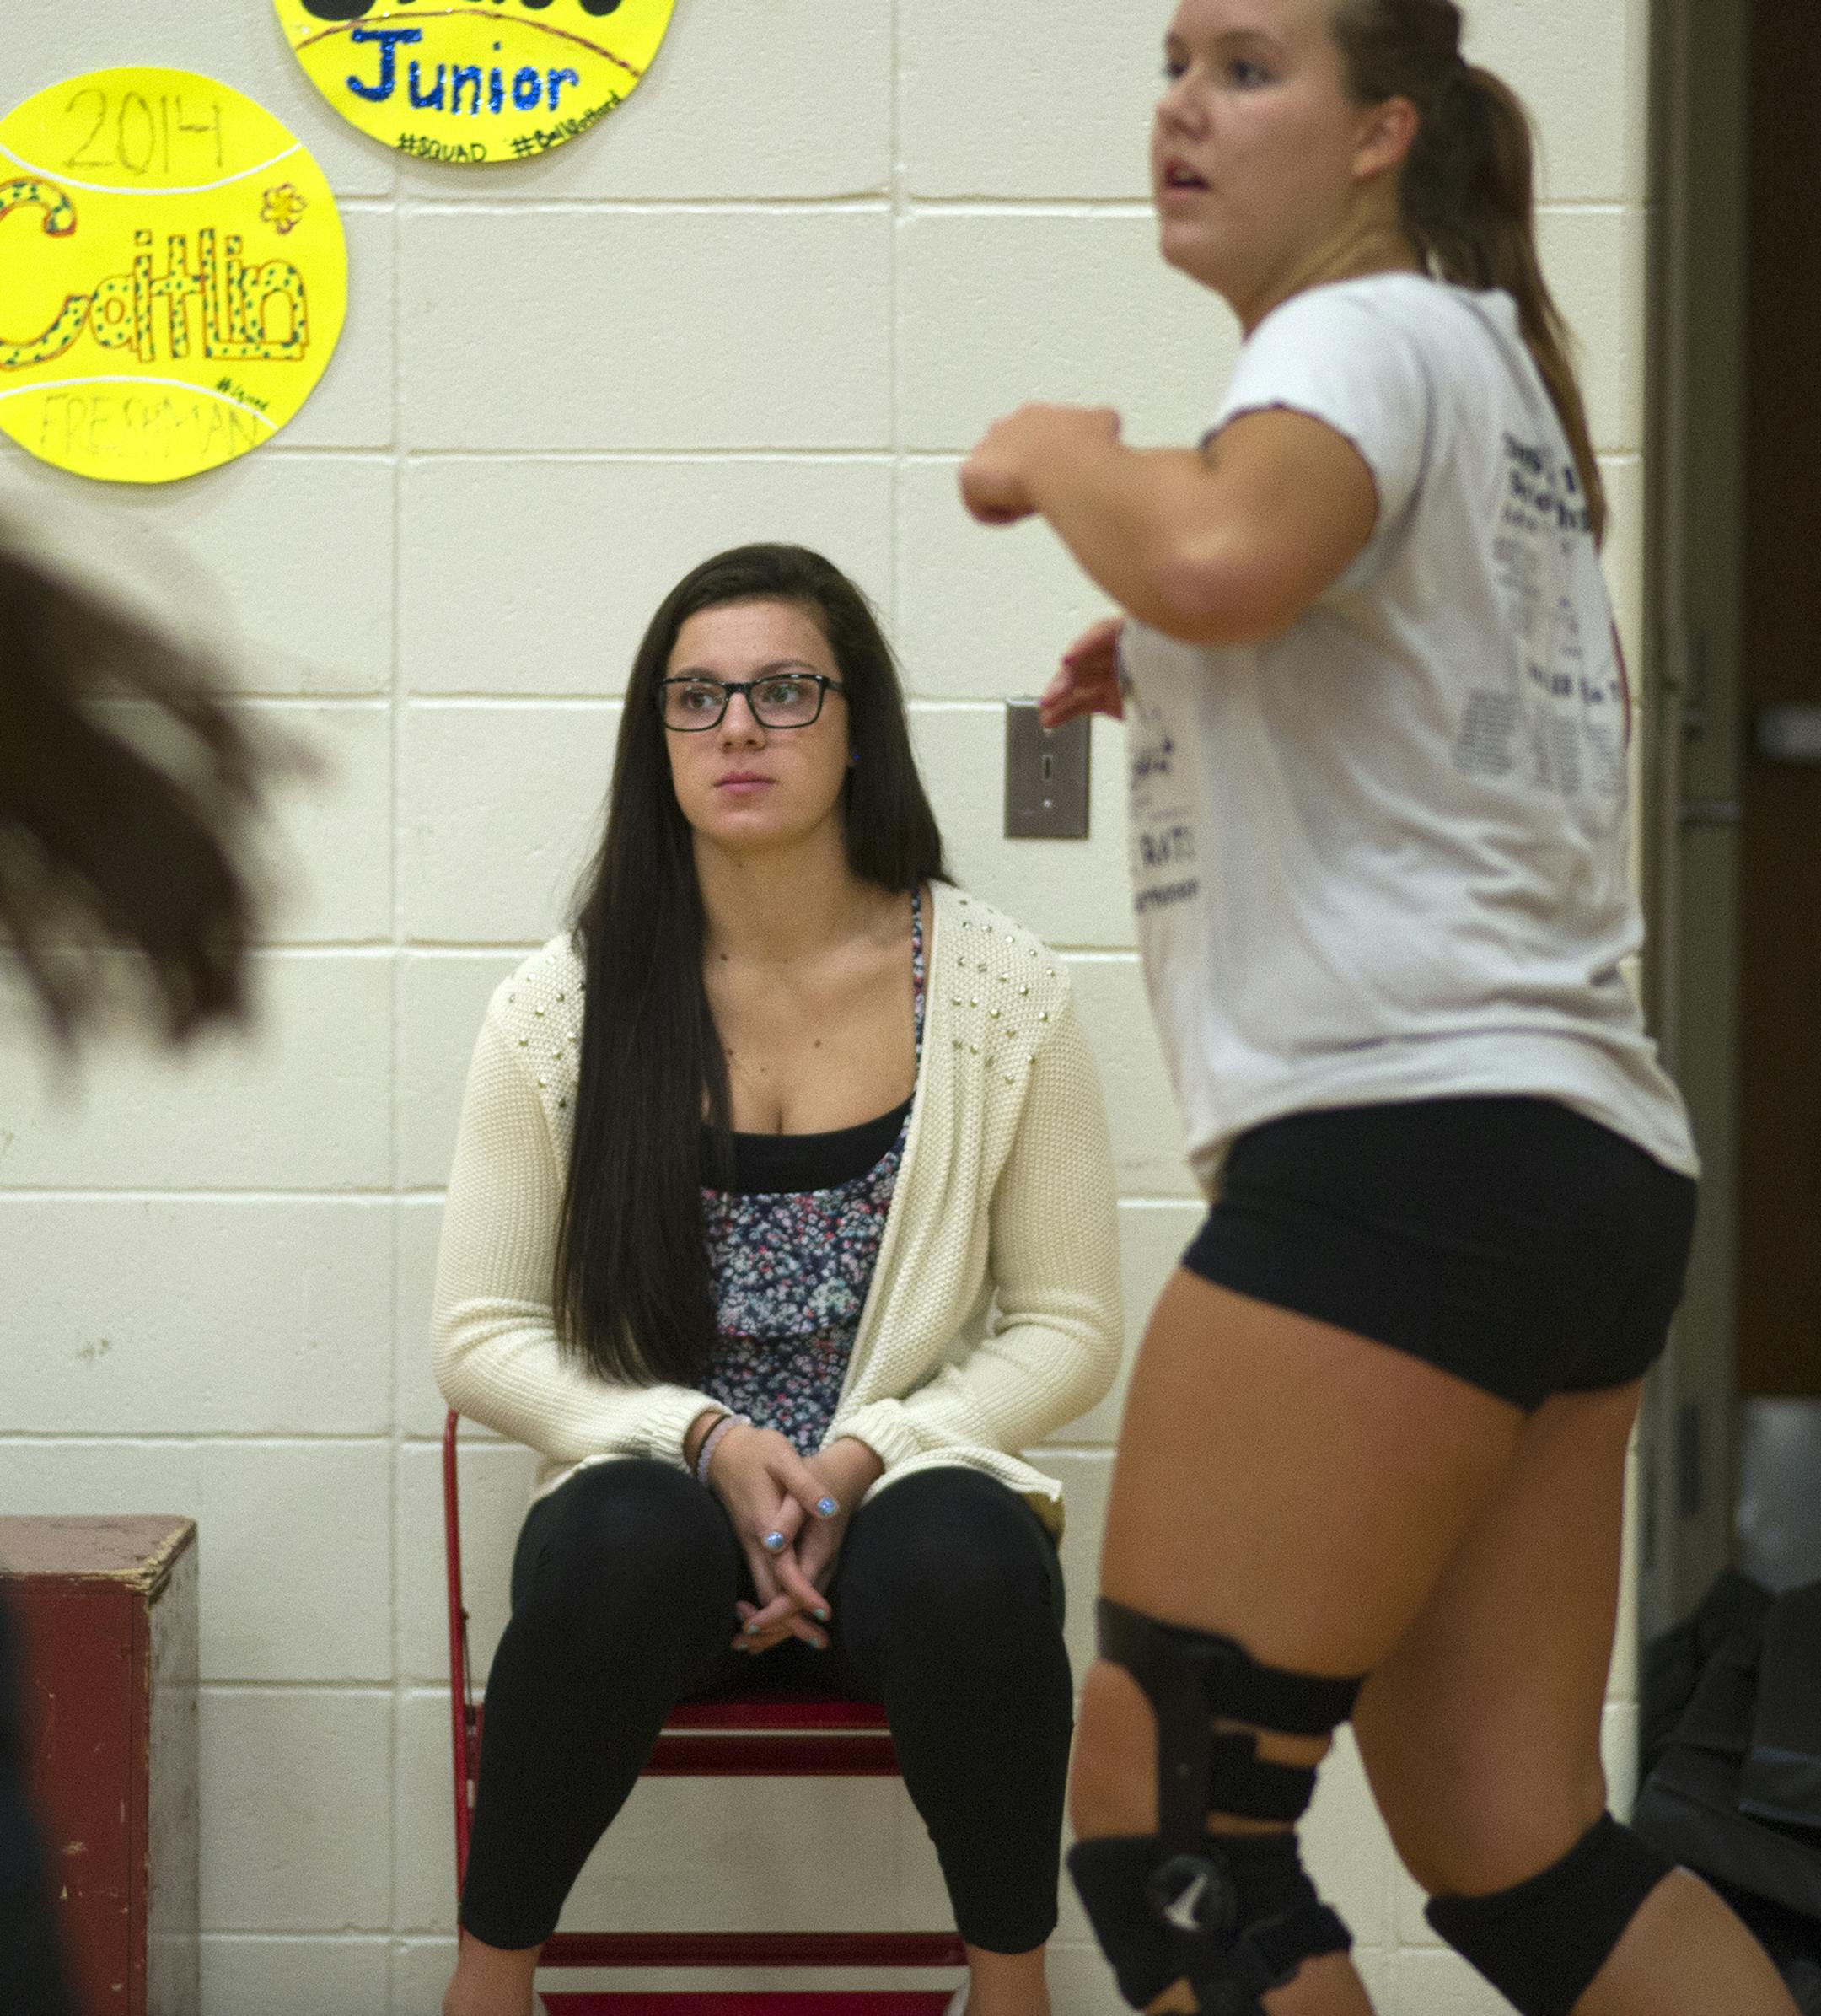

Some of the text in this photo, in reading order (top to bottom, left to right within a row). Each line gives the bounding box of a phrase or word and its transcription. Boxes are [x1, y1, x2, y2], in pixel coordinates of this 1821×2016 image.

[346, 28, 579, 116] Junior
[62, 88, 225, 175] 2014
[0, 176, 309, 372] Caitlin
